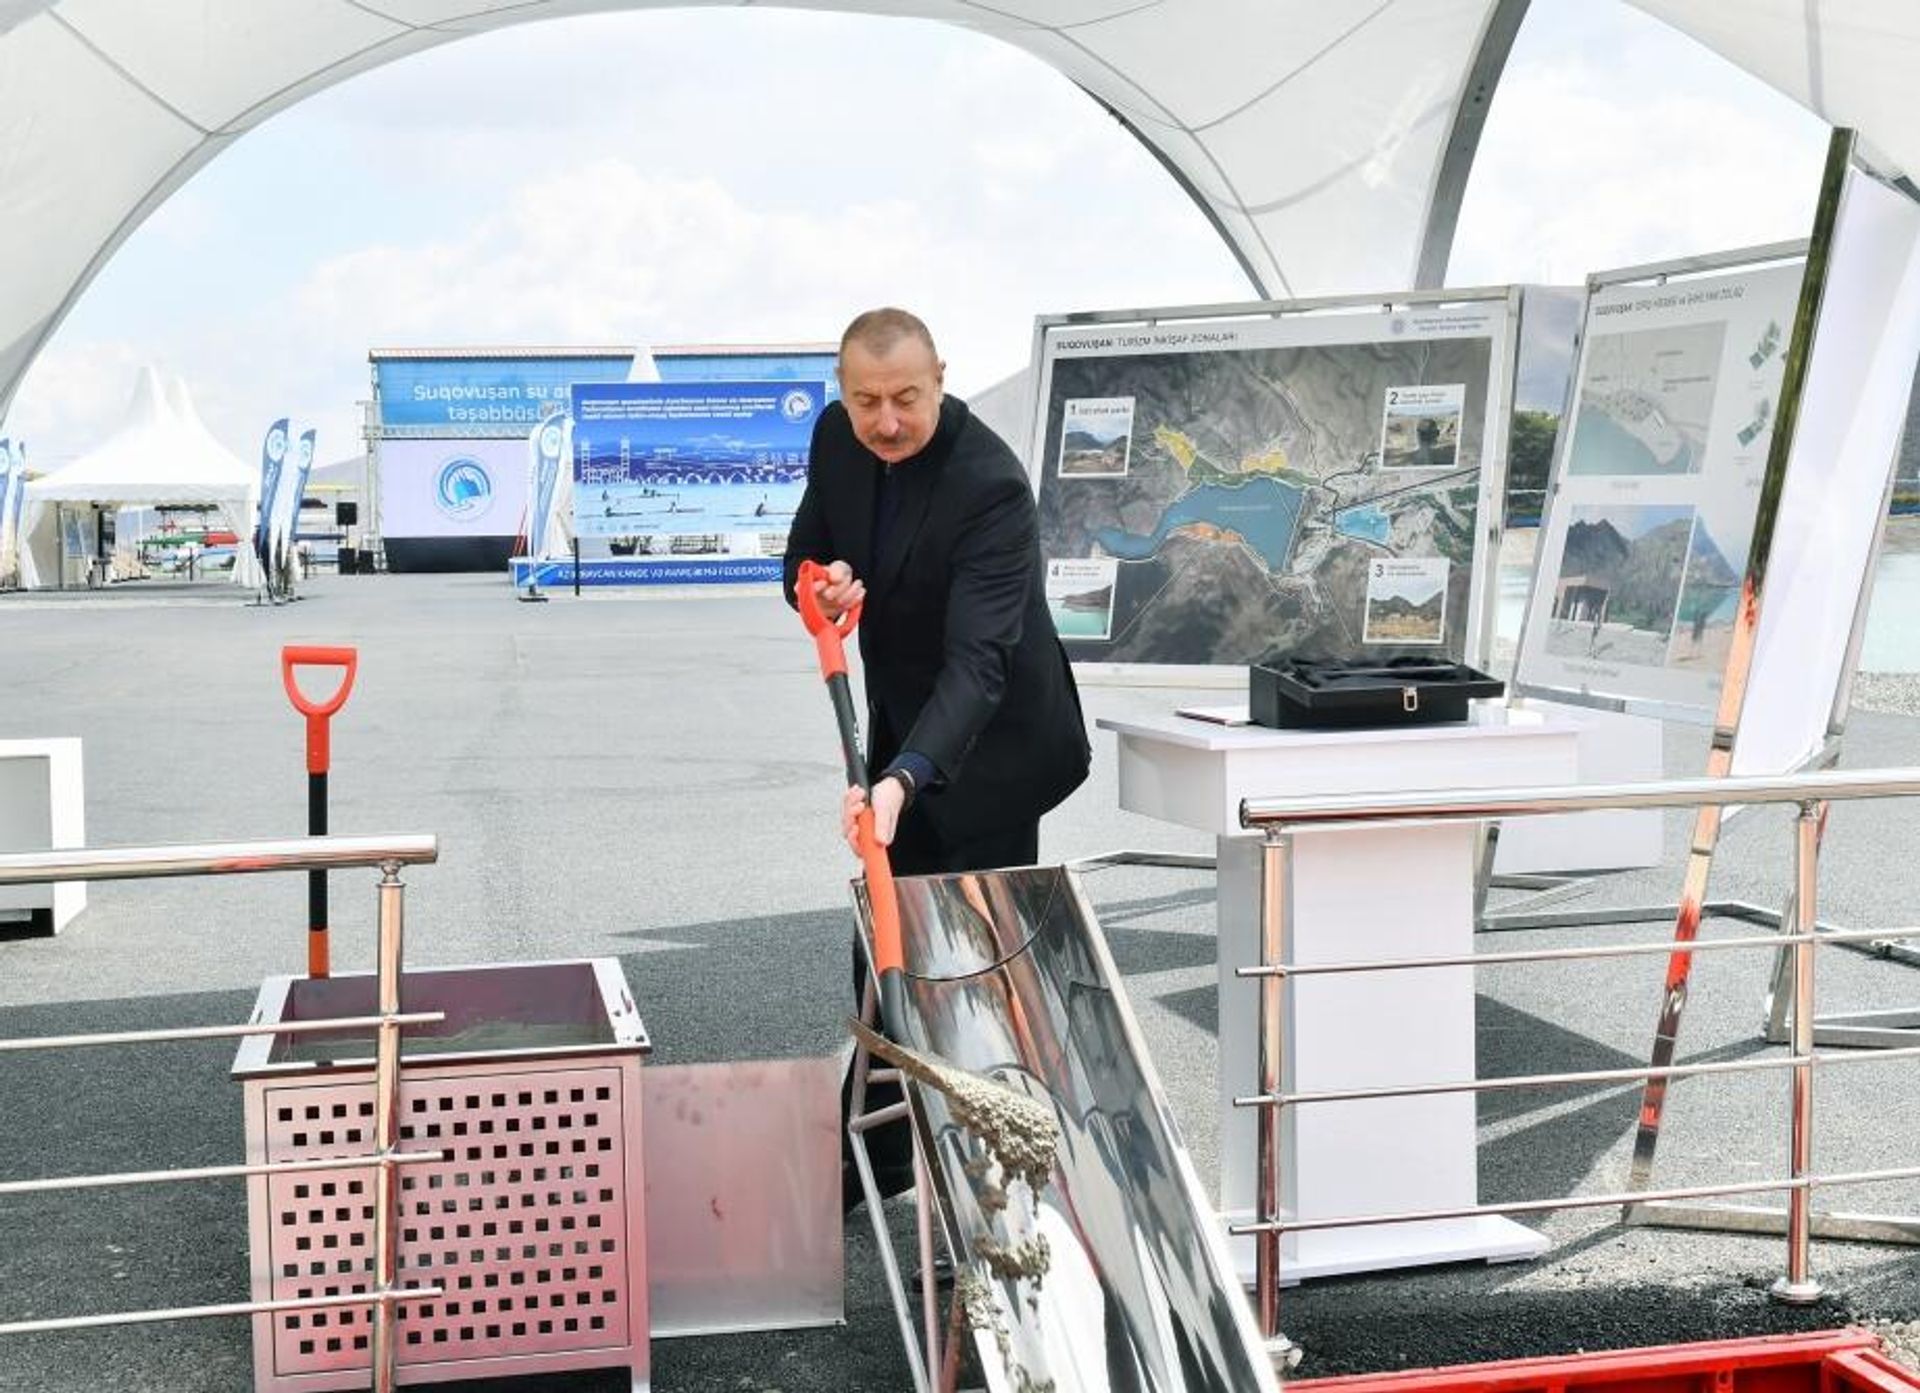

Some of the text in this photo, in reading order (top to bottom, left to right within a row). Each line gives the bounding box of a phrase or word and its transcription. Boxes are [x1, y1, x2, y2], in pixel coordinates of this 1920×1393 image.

[413, 384, 520, 401] Suqovuşan
[526, 387, 547, 399] su
[1389, 391, 1399, 405] 2
[448, 404, 545, 421] təşəbbüsl
[1070, 403, 1076, 416] 1
[1051, 563, 1059, 577] 4
[1375, 564, 1384, 578] 3
